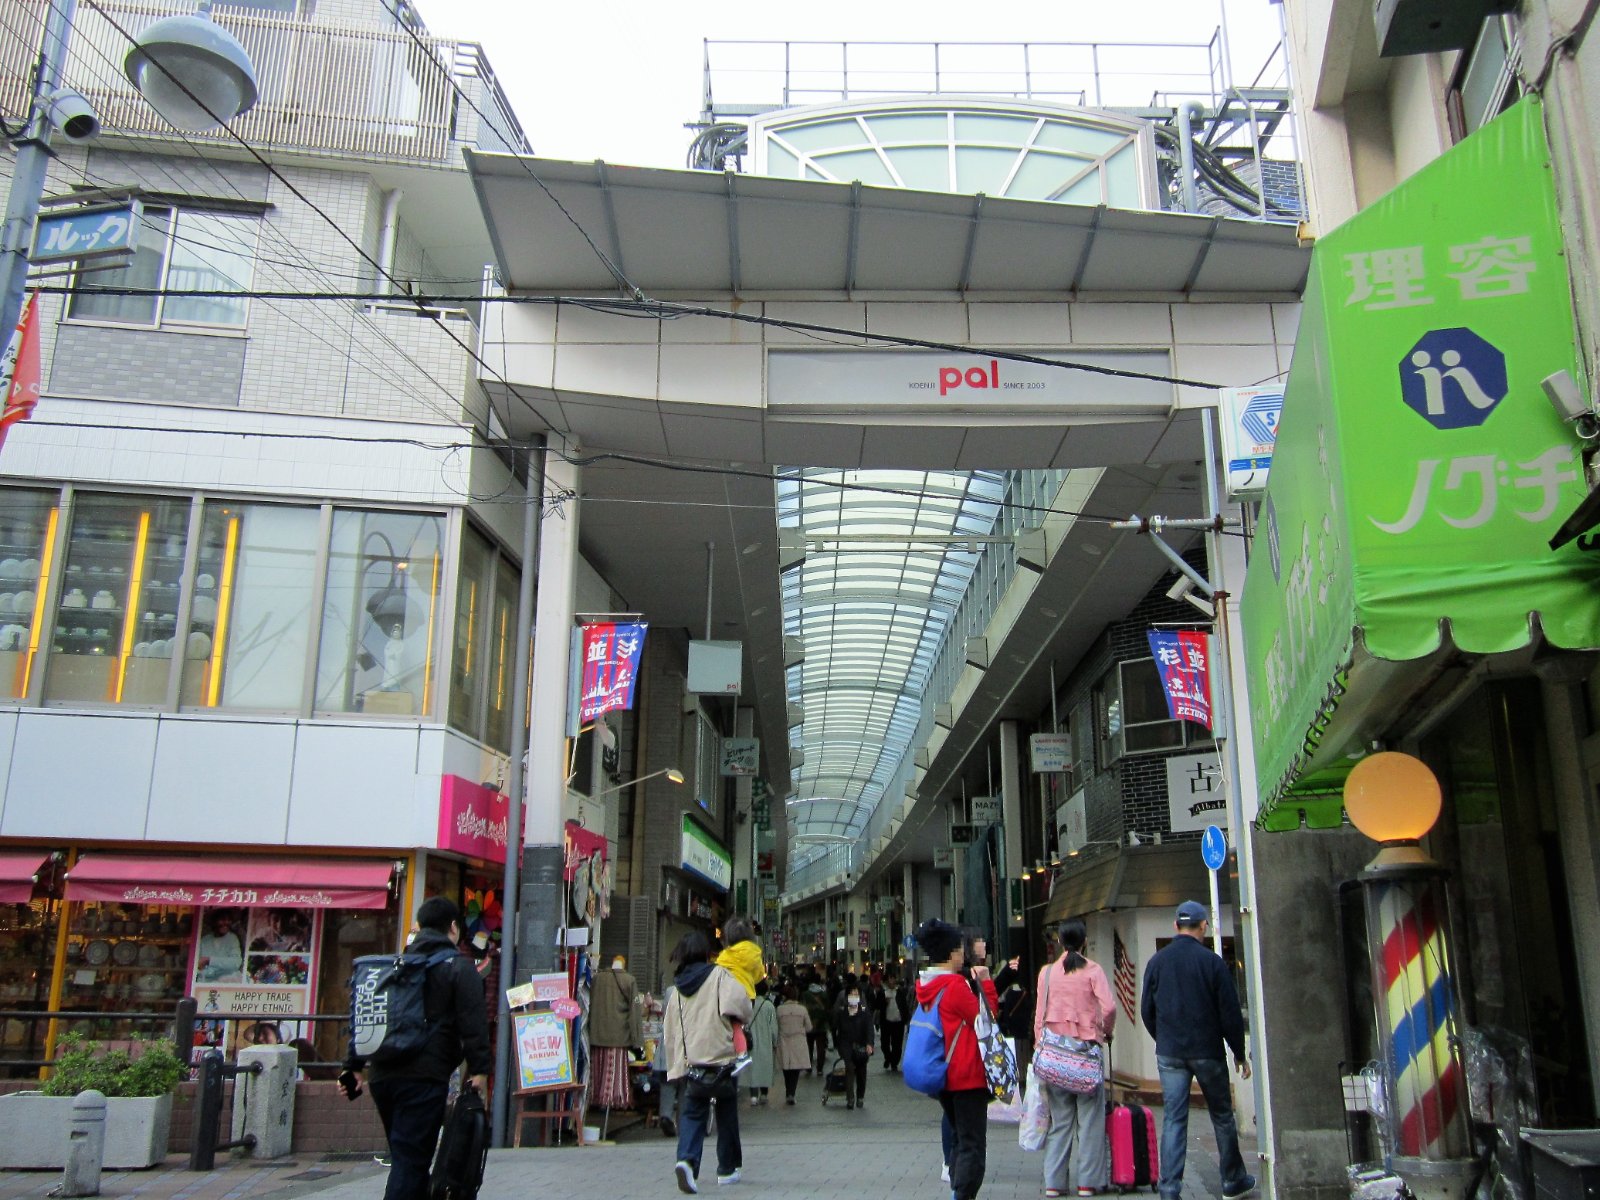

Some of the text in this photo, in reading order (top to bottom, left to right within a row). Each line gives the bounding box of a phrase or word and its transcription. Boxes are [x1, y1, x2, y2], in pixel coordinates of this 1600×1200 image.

[44, 214, 128, 251] ルック
[1343, 235, 1537, 312] 理容
[939, 360, 999, 396] pal
[1003, 382, 1025, 390] SINCE
[1366, 444, 1578, 535] ノグチ
[1157, 647, 1206, 672] 杉並
[726, 682, 739, 691] pal
[1195, 801, 1227, 813] Albatr
[201, 888, 257, 903] チチカカ
[230, 1003, 294, 1013] HAPPY ETHNIC
[234, 992, 292, 1002] HAPPY TRADE
[354, 984, 365, 1025] FACE
[362, 968, 381, 1025] NORTH
[373, 991, 388, 1024] THE
[522, 1035, 562, 1055] NEW
[528, 1052, 560, 1061] ARRIVAL
